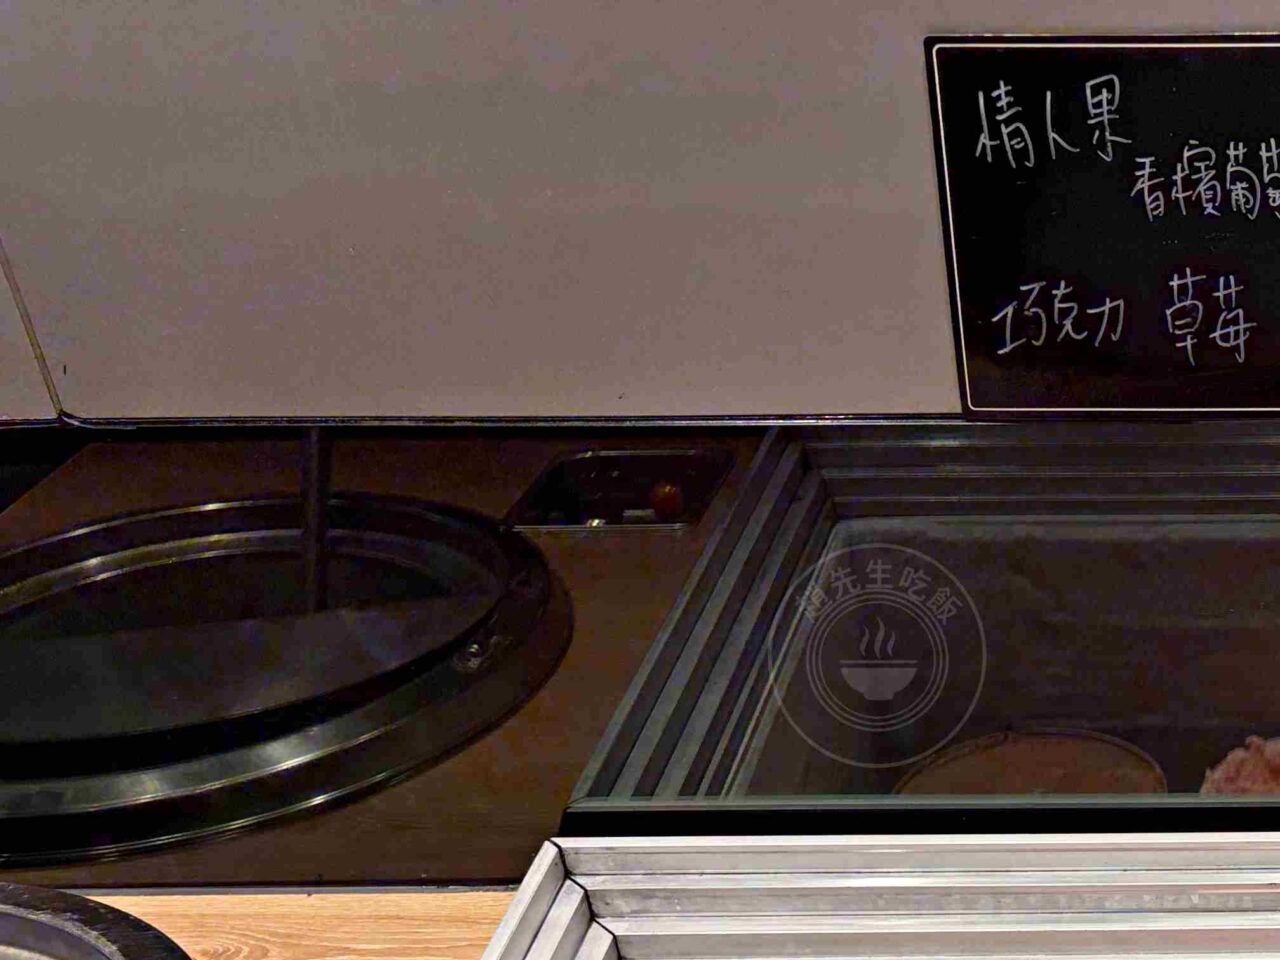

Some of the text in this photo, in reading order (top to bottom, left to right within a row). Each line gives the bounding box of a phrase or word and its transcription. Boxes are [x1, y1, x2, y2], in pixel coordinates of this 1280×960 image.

[975, 74, 1131, 168] 情人果
[990, 280, 1125, 354] 巧克力
